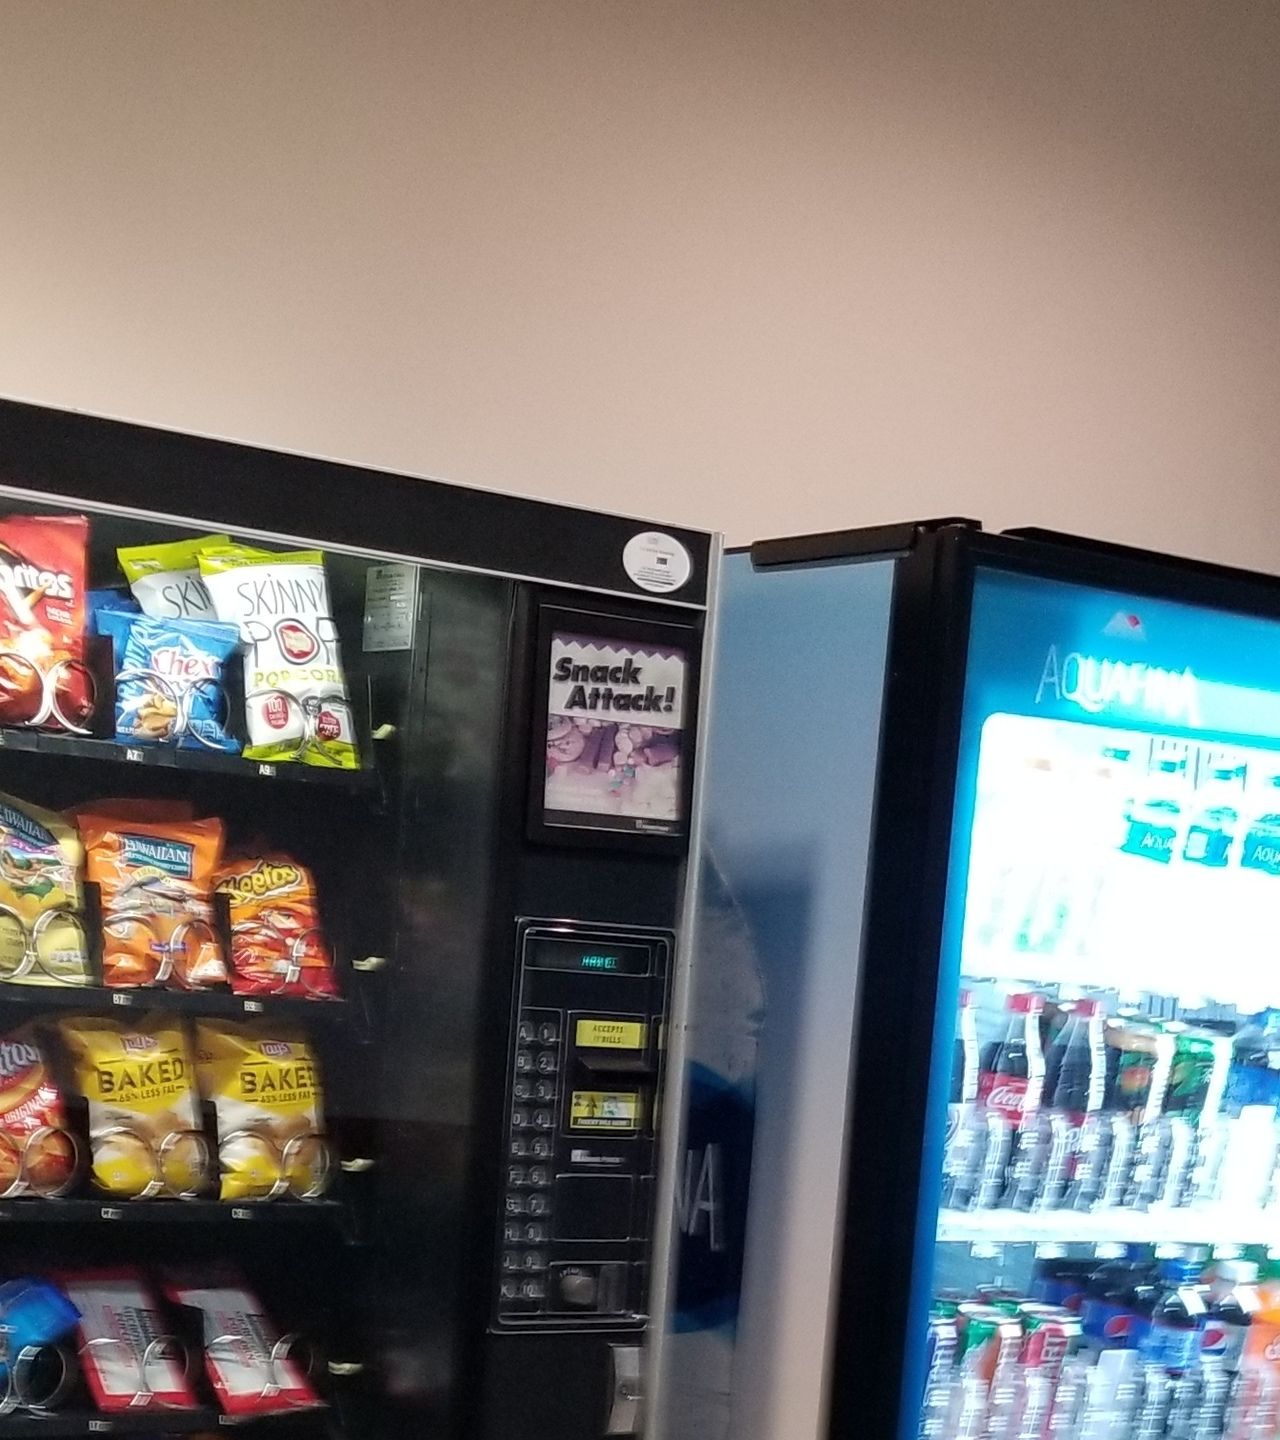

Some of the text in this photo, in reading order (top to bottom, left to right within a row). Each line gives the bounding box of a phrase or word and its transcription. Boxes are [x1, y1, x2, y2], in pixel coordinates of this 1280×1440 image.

[237, 572, 324, 617] SKINNY
[243, 616, 340, 668] POP
[153, 647, 214, 677] Chex
[552, 656, 642, 685] Snack
[564, 684, 676, 714] Attack!
[98, 1057, 185, 1094] BAKED
[141, 1087, 161, 1100] LESS
[280, 1093, 297, 1102] LESS
[298, 1091, 311, 1101] FAT
